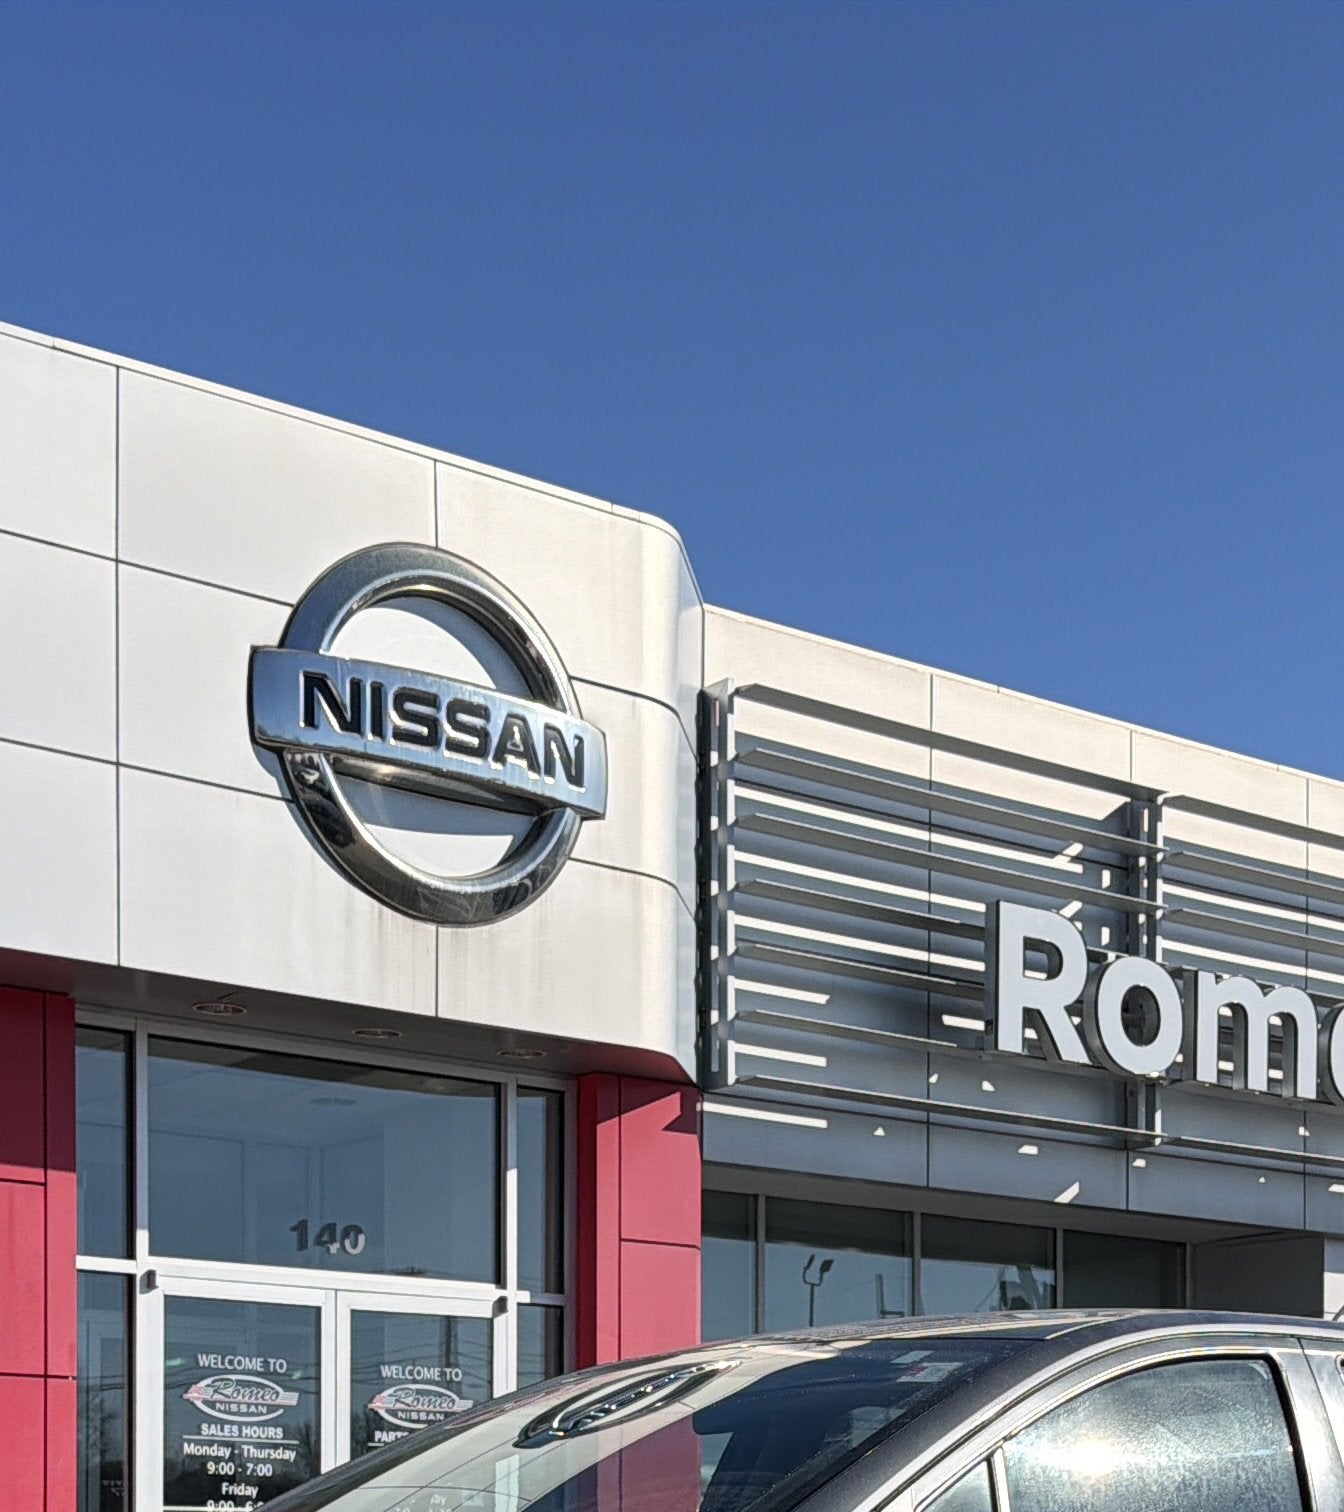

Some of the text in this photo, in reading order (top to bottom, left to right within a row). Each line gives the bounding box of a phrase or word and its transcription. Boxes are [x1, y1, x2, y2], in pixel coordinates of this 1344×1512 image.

[299, 669, 587, 793] NISSAN
[289, 1219, 365, 1255] 140
[197, 1353, 287, 1373] WELCOME TO
[380, 1365, 463, 1382] WELCOME TO
[205, 1377, 281, 1402] Romeo
[390, 1387, 456, 1410] Romeo
[215, 1402, 267, 1414] NISSAN
[397, 1411, 444, 1422] NISSAN
[200, 1423, 284, 1439] SALES HOURS
[183, 1442, 232, 1459] Monday
[241, 1444, 297, 1462] Thursday
[207, 1461, 235, 1475] 9:00
[246, 1463, 273, 1476] 7:00
[221, 1482, 259, 1499] Friday
